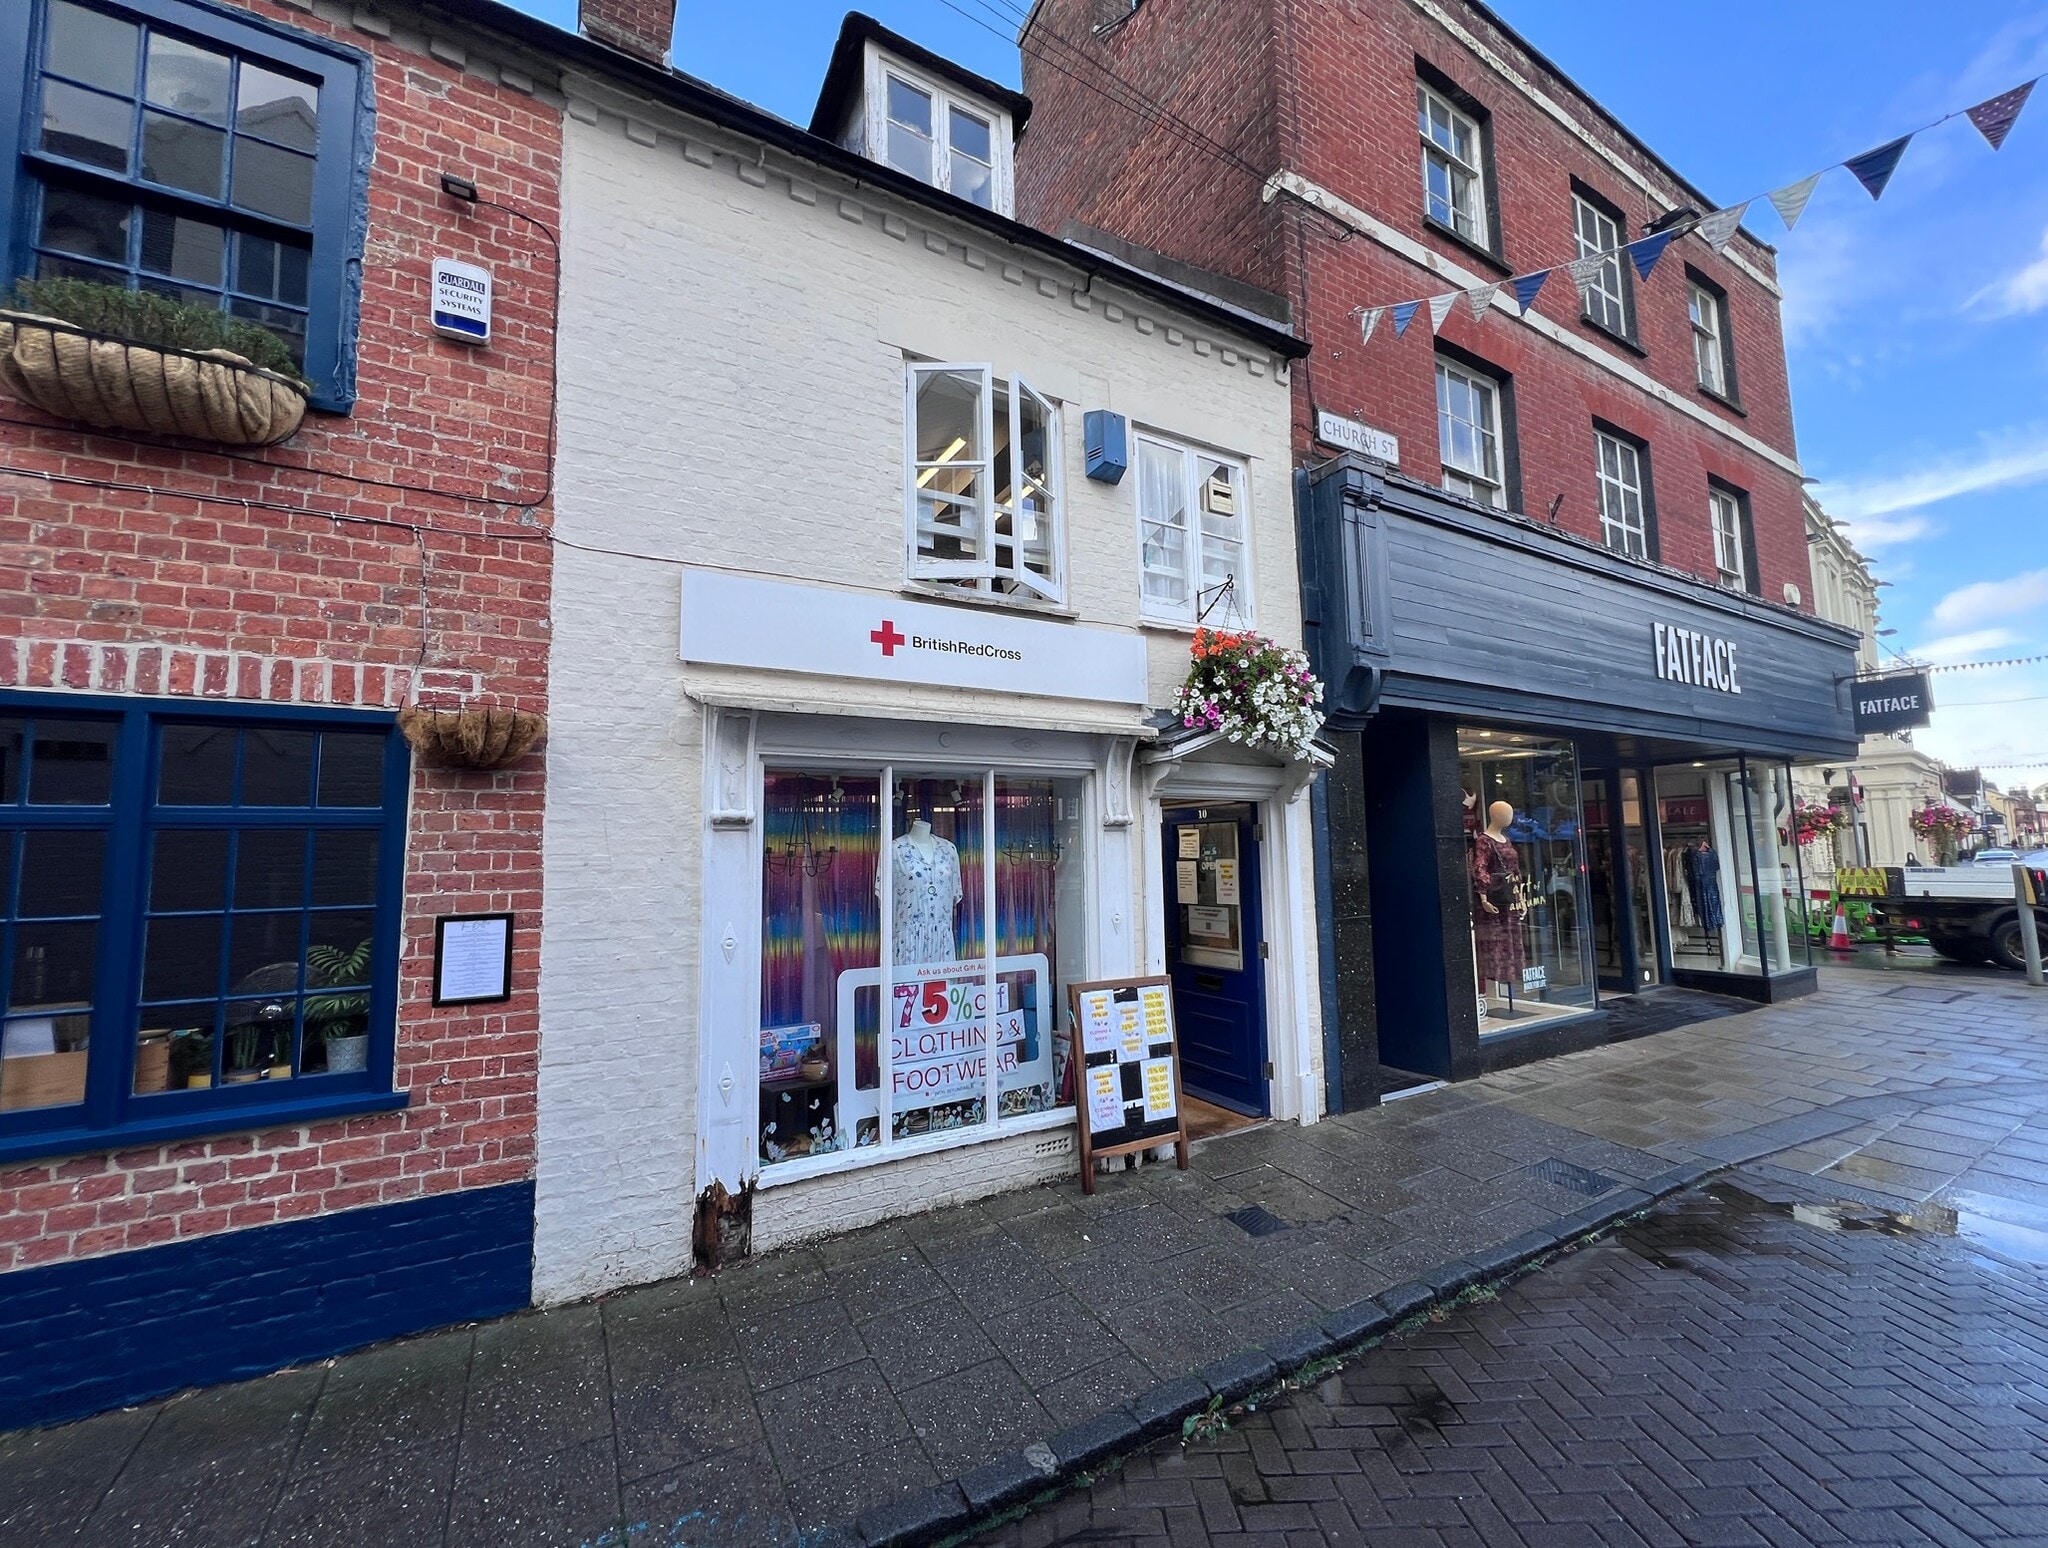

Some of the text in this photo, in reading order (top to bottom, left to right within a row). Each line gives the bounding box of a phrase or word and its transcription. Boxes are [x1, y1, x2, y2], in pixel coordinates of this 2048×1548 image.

[439, 273, 485, 295] GUARDALL
[439, 288, 483, 304] SECURITY
[440, 300, 481, 315] SYSTEMS
[1324, 421, 1377, 450] CHURCH
[912, 636, 1022, 661] BritishRedCross
[1654, 622, 1741, 694] FATFACE
[1860, 695, 1920, 715] FATFACE
[1198, 809, 1207, 819] 10
[1512, 874, 1532, 901] art
[1509, 893, 1546, 911] autumn
[917, 969, 931, 977] Ask
[943, 966, 962, 974] about
[963, 964, 976, 972] Gift
[1522, 965, 1545, 982] FATFACE
[893, 981, 1005, 1028] 75% of
[1009, 1018, 1021, 1037] &
